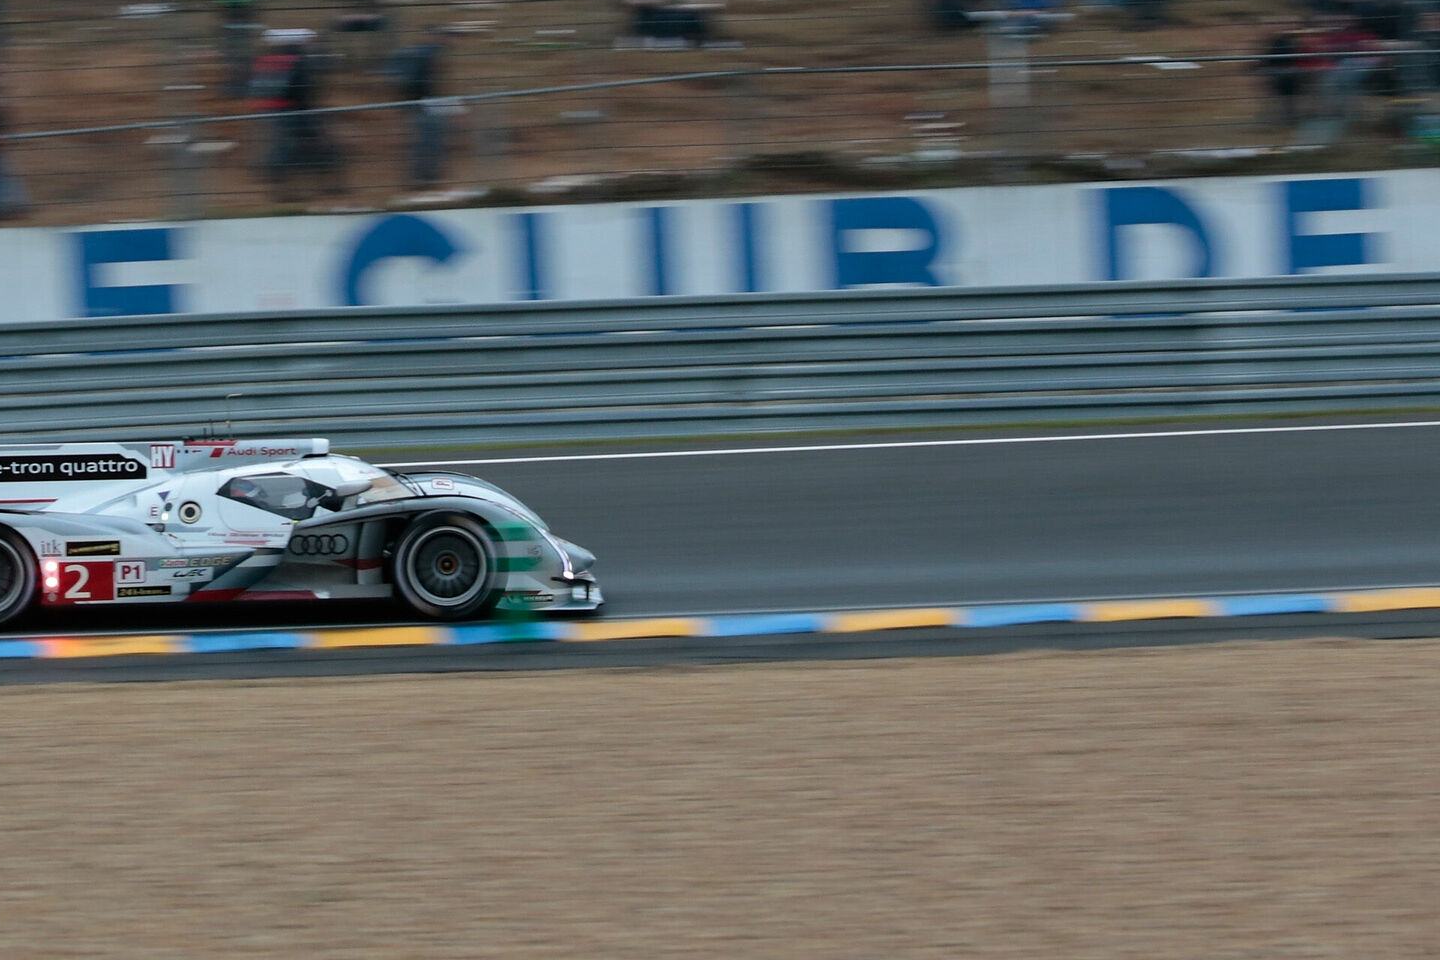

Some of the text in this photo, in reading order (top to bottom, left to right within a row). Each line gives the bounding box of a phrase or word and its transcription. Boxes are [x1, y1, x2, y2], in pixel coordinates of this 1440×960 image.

[150, 445, 174, 467] HY
[227, 447, 296, 457] Audi Sport
[59, 458, 139, 476] quattro
[189, 557, 232, 567] EDGE
[121, 565, 140, 580] P1
[64, 564, 91, 599] 2
